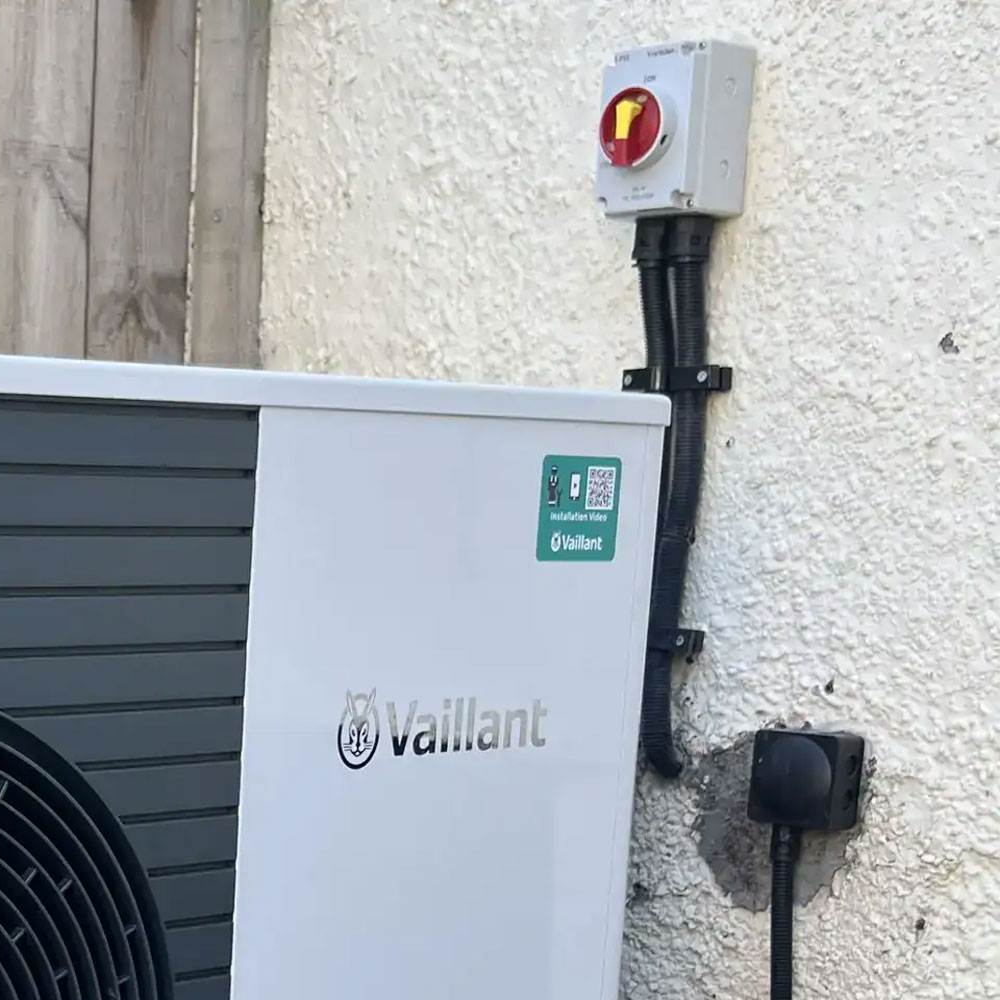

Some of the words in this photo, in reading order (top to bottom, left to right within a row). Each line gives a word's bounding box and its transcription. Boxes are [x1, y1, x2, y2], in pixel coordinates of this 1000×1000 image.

[550, 511, 588, 521] Installation
[589, 512, 608, 522] Video
[562, 534, 603, 551] Vaillant
[386, 696, 548, 756] Vaillant
